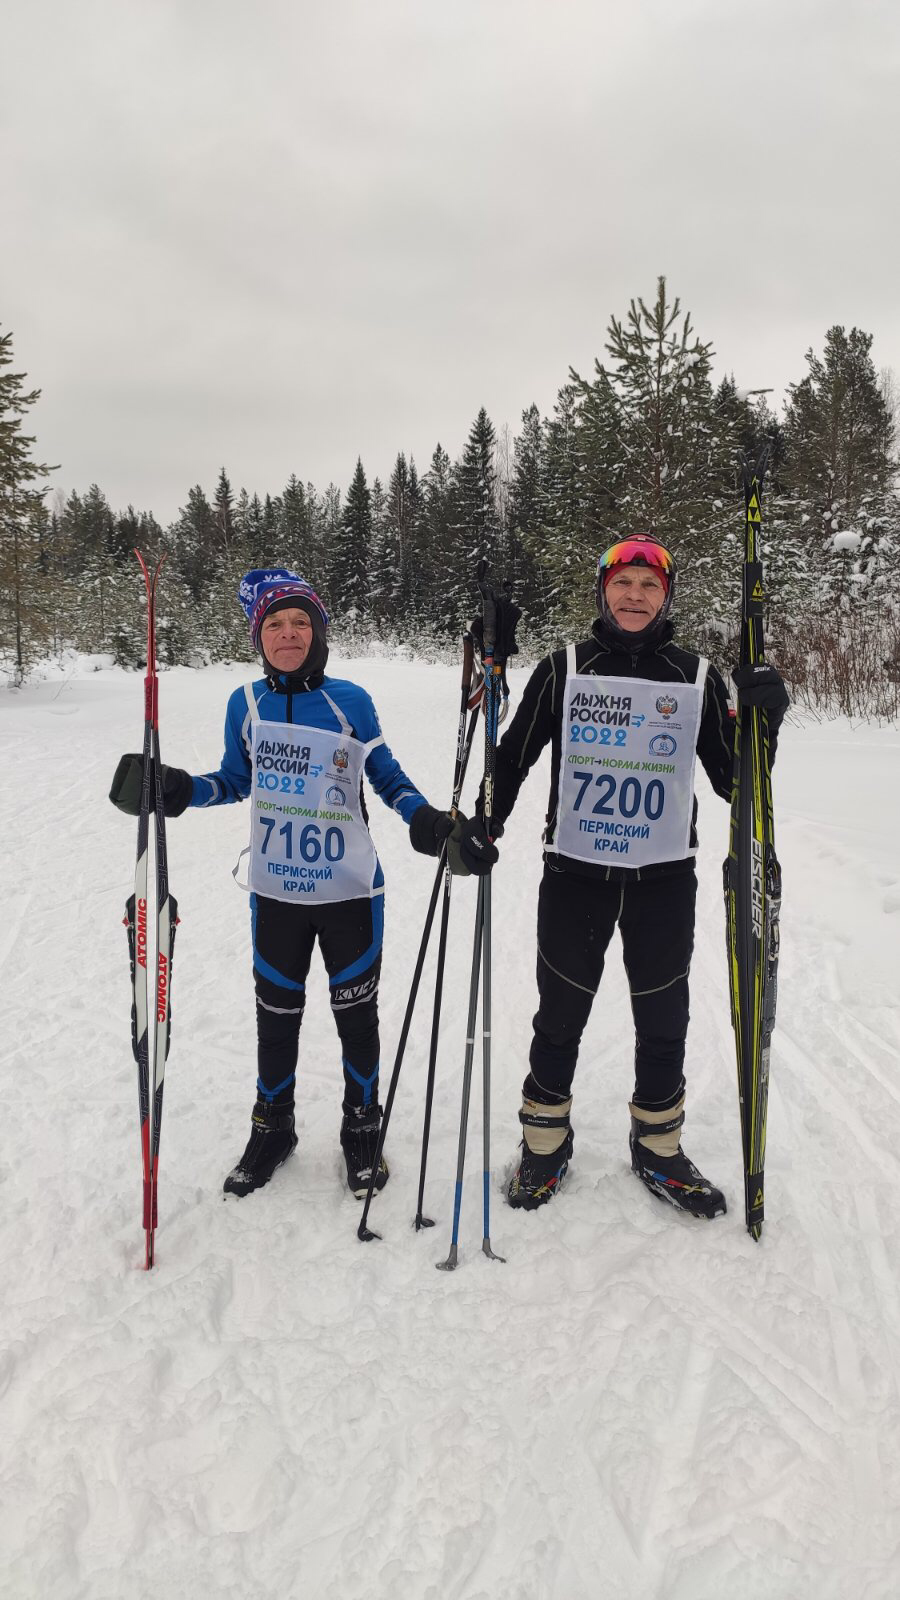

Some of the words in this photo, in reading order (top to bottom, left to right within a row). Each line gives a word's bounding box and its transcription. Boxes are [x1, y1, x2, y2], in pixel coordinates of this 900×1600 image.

[569, 692, 632, 711] ЛЫЖНЯ
[569, 707, 631, 727] РОССИИ
[569, 724, 627, 747] 2022
[256, 740, 311, 760] ЛЫЖНЯ
[256, 756, 309, 776] РОССИИ
[567, 754, 595, 766] СПОРТ
[641, 761, 676, 774] ЖИЗНИ
[256, 771, 306, 795] 2022
[572, 771, 665, 821] 7200
[579, 818, 650, 839] ПЕРМСКИЙ
[259, 816, 345, 863] 7160
[594, 838, 630, 854] КРАЙ
[267, 862, 333, 880] ПЕРМСКИЙ
[283, 880, 316, 893] КРАЙ
[752, 837, 763, 939] FISCHER
[137, 898, 147, 969] ATOMIC
[157, 951, 168, 1023] ATOMIC
